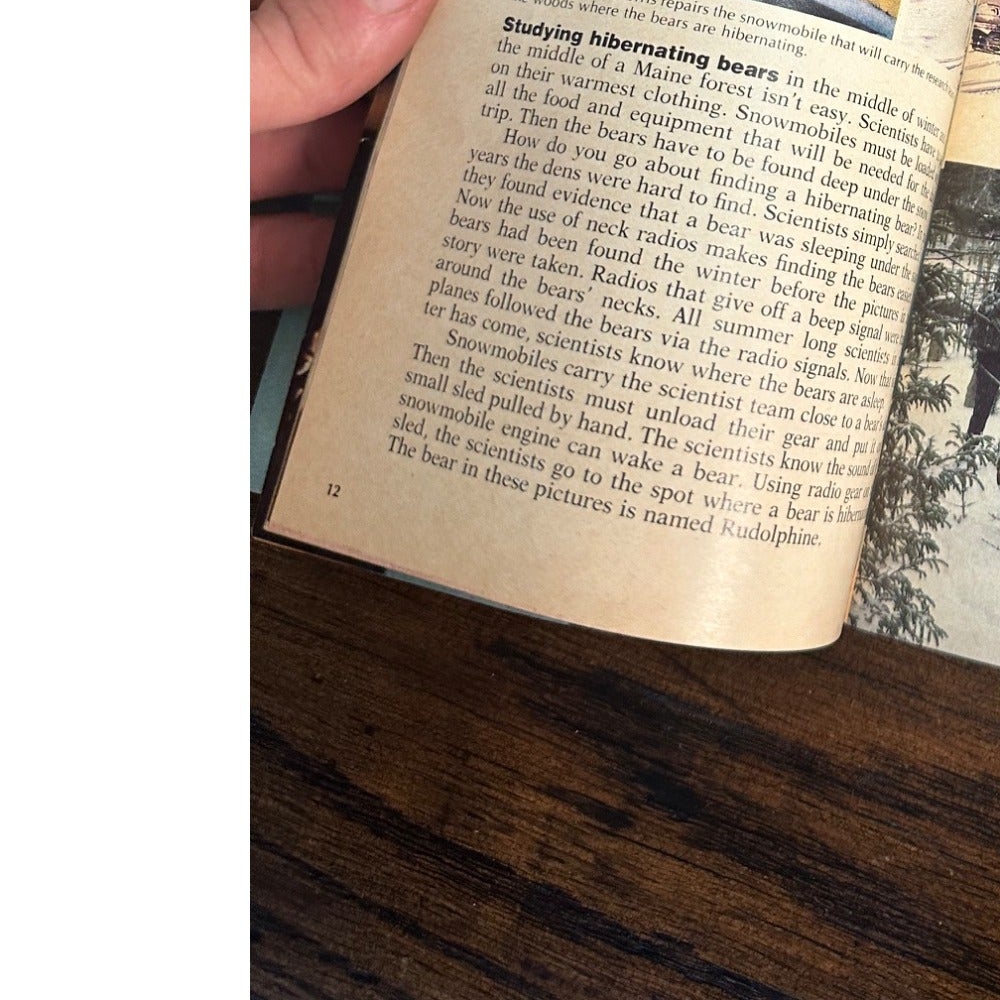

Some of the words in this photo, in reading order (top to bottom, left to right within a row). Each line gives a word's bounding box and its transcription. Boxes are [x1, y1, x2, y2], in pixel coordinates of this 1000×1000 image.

[503, 16, 583, 46] Studying
[588, 30, 710, 70] hibernating
[717, 54, 779, 82] bears
[786, 70, 804, 88] in
[813, 78, 840, 97] the
[848, 86, 899, 117] middle
[902, 108, 916, 123] of
[579, 0, 619, 17] where
[624, 6, 645, 21] the
[650, 10, 688, 29] bears
[693, 23, 716, 35] are
[721, 24, 806, 57] hibernating.
[713, 5, 736, 21] the
[740, 14, 827, 42] snowmobile
[831, 34, 855, 51] that
[859, 43, 882, 60] will
[883, 53, 910, 73] carry
[912, 63, 925, 78] the
[497, 36, 521, 55] the
[527, 44, 585, 65] middle
[590, 53, 612, 70] of
[614, 61, 625, 73] a
[632, 59, 692, 85] Maine
[699, 72, 752, 99] forest
[810, 104, 851, 125] easy.
[859, 113, 919, 149] Scientists
[481, 103, 512, 124] trip.
[520, 108, 558, 129] Then
[564, 116, 591, 135] the
[597, 121, 648, 146] bears
[652, 131, 699, 156] have
[707, 146, 725, 161] to
[732, 148, 755, 168] be
[761, 155, 815, 182] found
[821, 171, 858, 197] deep
[863, 186, 900, 207] under
[902, 194, 915, 213] the
[463, 166, 496, 191] they
[500, 173, 547, 197] found
[552, 188, 632, 215] evidence
[640, 201, 679, 224] that
[686, 216, 697, 228] a
[706, 213, 751, 238] bear
[760, 231, 795, 248] was
[801, 236, 866, 270] sleeping
[870, 257, 900, 276] under
[441, 235, 481, 259] story
[487, 244, 526, 265] were
[531, 253, 583, 278] taken.
[591, 264, 658, 294] Radios
[666, 280, 706, 303] that
[712, 292, 754, 313] give
[761, 301, 789, 320] off
[791, 311, 801, 323] a
[808, 308, 845, 336] beep
[849, 319, 883, 341] signal
[446, 328, 558, 372] Snowmobiles
[564, 362, 614, 388] carry
[621, 371, 652, 393] the
[658, 383, 743, 411] scientist
[750, 399, 794, 420] team
[800, 407, 837, 428] close
[841, 414, 853, 429] to
[855, 418, 861, 430] a
[327, 483, 341, 498] 12
[388, 434, 416, 458] The
[421, 443, 458, 471] bear
[462, 458, 478, 478] in
[484, 464, 529, 492] these
[535, 482, 613, 512] pictures
[619, 499, 636, 519] is
[644, 509, 714, 533] named
[721, 519, 821, 548] Rudolphine.
